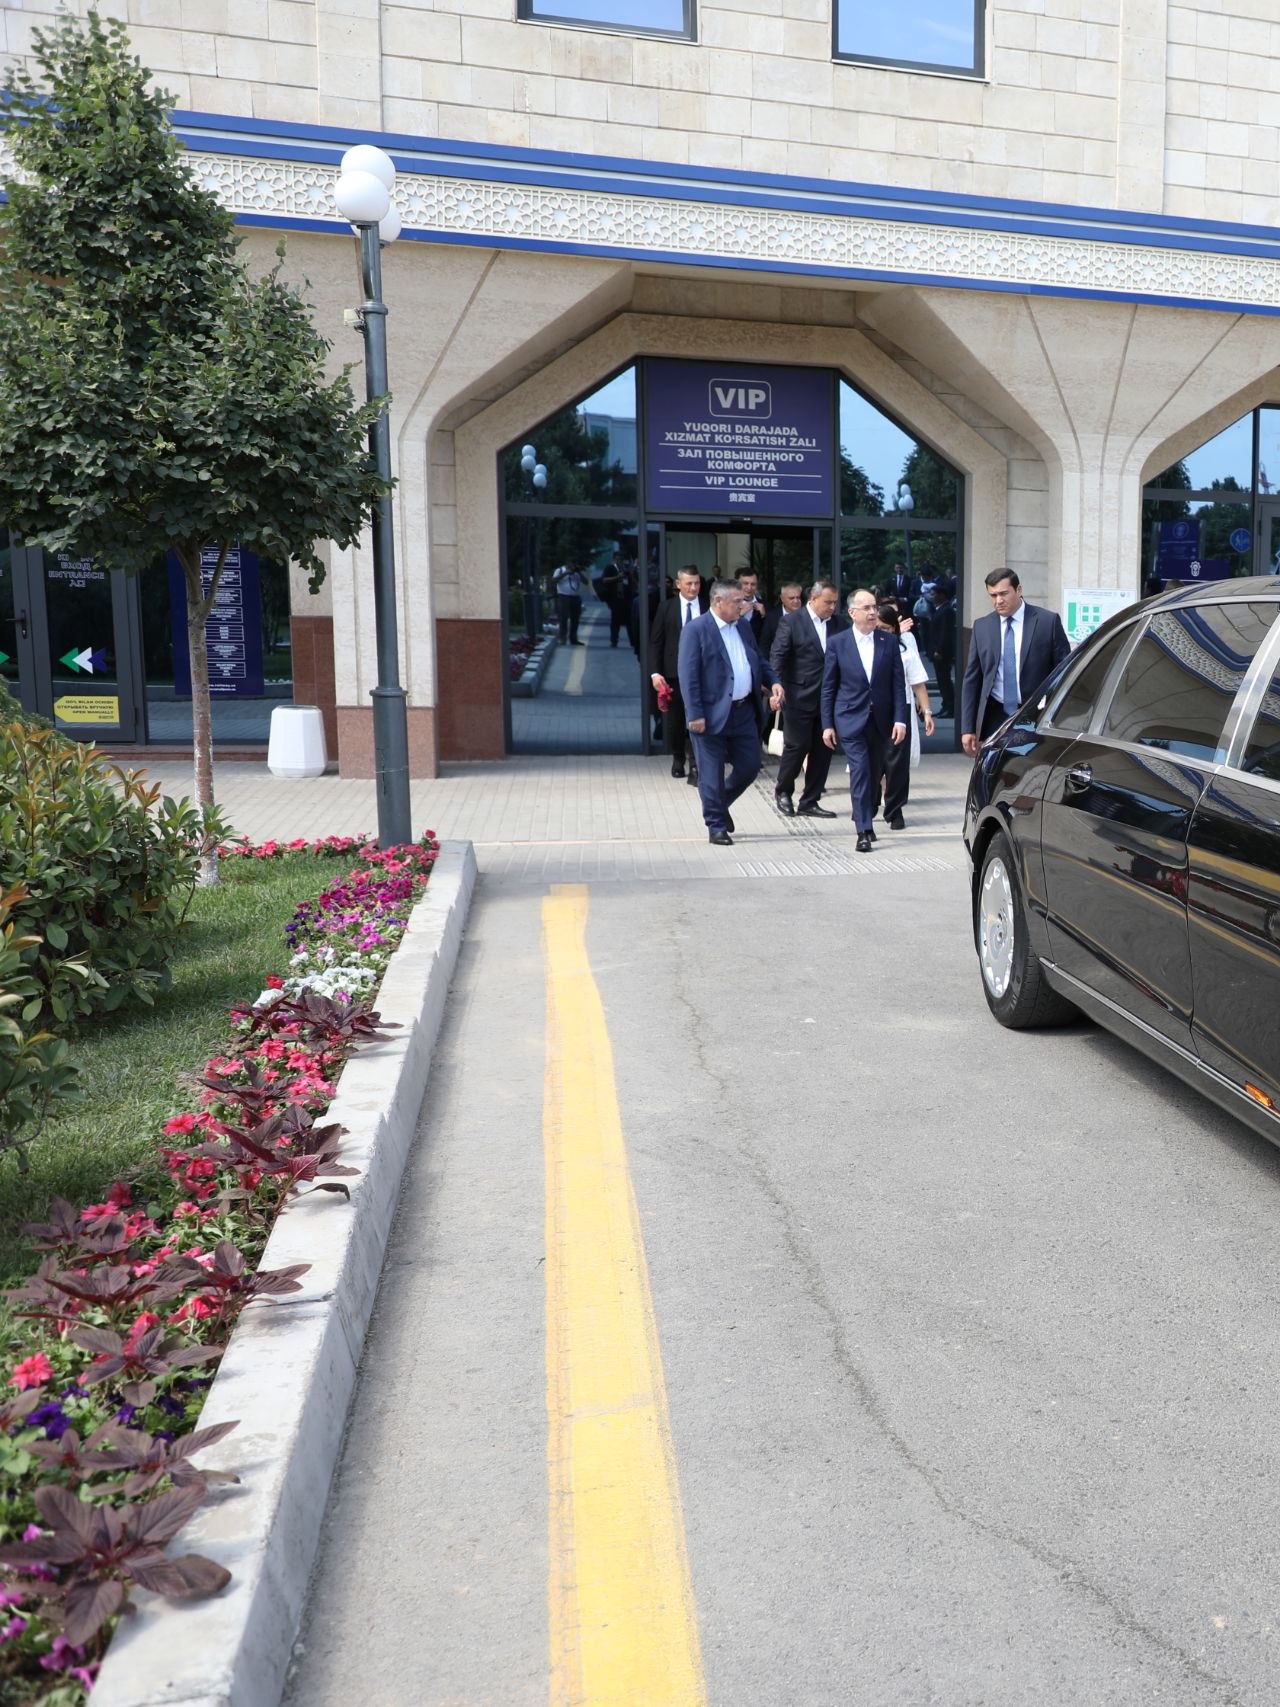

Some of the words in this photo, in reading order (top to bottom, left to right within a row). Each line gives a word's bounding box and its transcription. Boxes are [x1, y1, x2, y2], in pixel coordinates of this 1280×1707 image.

[714, 387, 767, 410] VIP
[684, 422, 732, 433] YUQORI
[735, 424, 798, 436] DARAJADA
[665, 432, 711, 443] XIZMAT
[790, 437, 816, 447] ZALI
[677, 448, 702, 458] ЗАЛ
[706, 450, 804, 462] ПОВЫШЕННОГО
[707, 460, 777, 471] КОМФОРТА
[705, 476, 725, 485] VIP
[729, 477, 778, 487] LOUNGE
[48, 570, 105, 580] ENTRANCE
